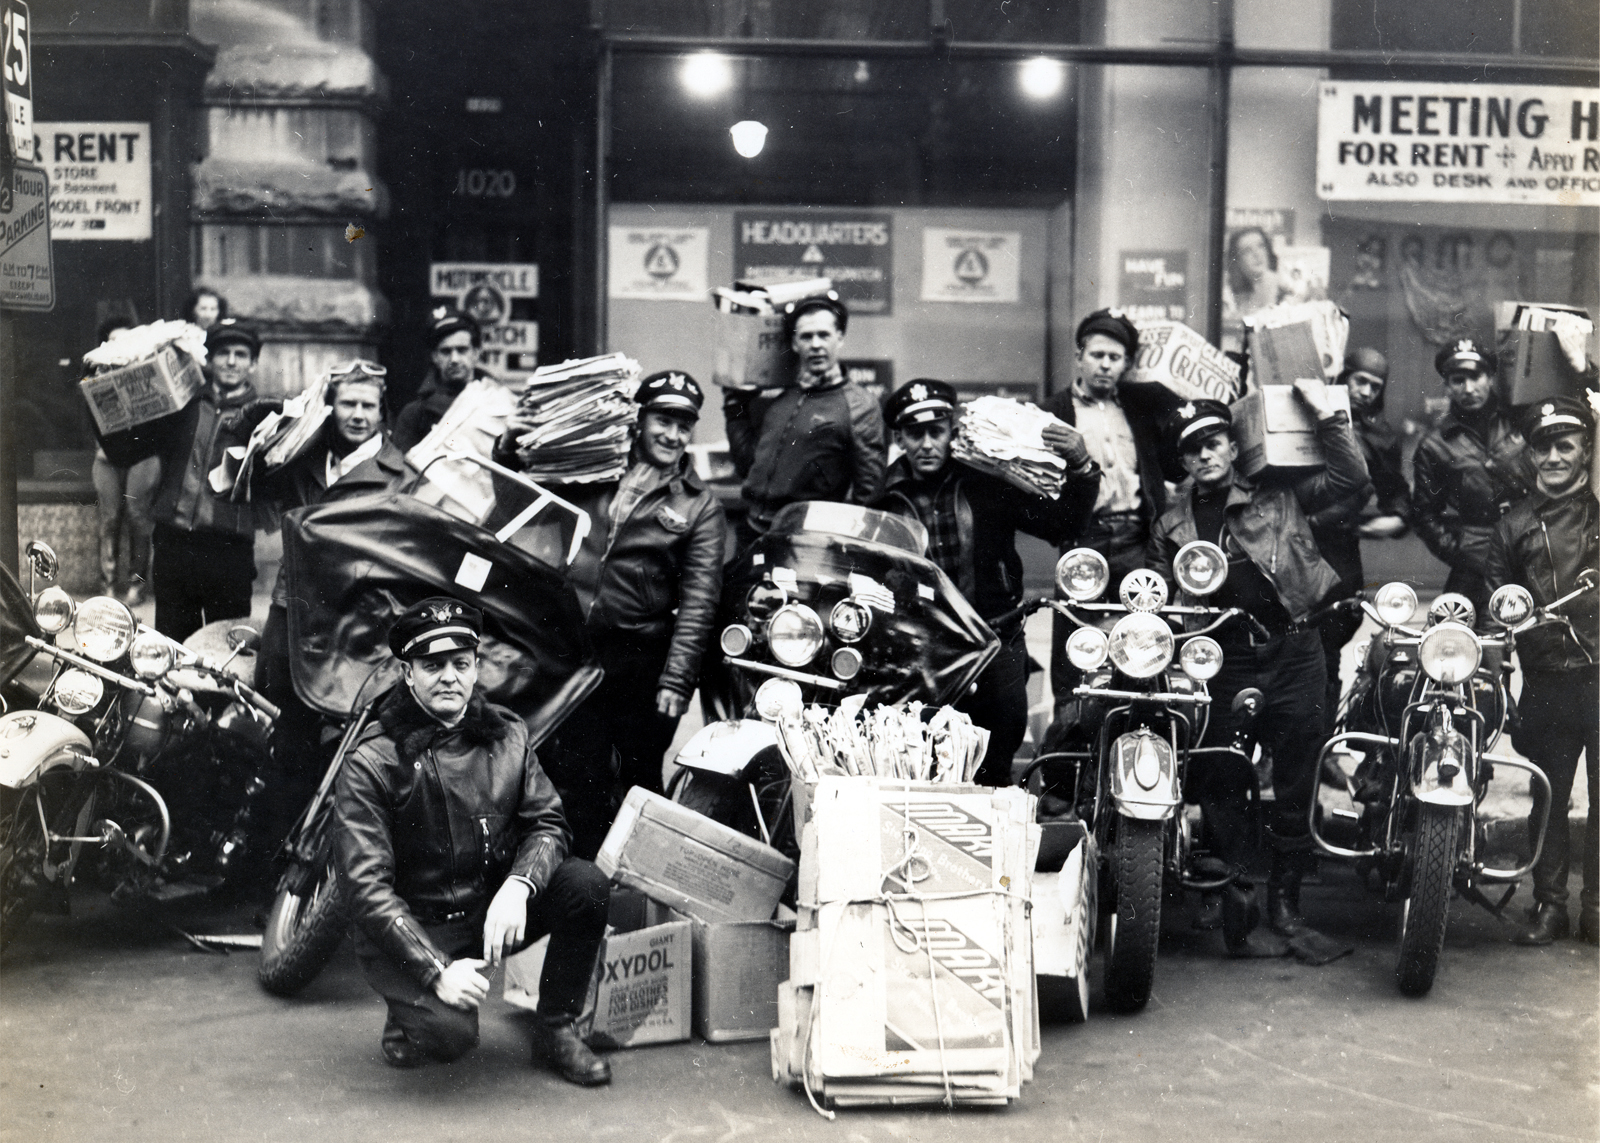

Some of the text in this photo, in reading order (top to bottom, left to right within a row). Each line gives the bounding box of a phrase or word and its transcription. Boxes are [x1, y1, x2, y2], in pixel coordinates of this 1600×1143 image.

[4, 7, 28, 86] 25
[1353, 94, 1549, 139] MEETING
[54, 132, 140, 164] RENT
[1338, 141, 1399, 166] FOR
[1411, 143, 1490, 168] RENT
[53, 167, 98, 180] STORE
[457, 169, 516, 197] 1020
[1366, 171, 1418, 188] ALSO
[1432, 172, 1493, 188] DESK
[1506, 177, 1538, 190] AND
[95, 199, 141, 214] FRONT
[741, 221, 889, 246] HEADQUARTERS
[1169, 344, 1226, 402] CRISCO
[650, 934, 674, 948] GIANT
